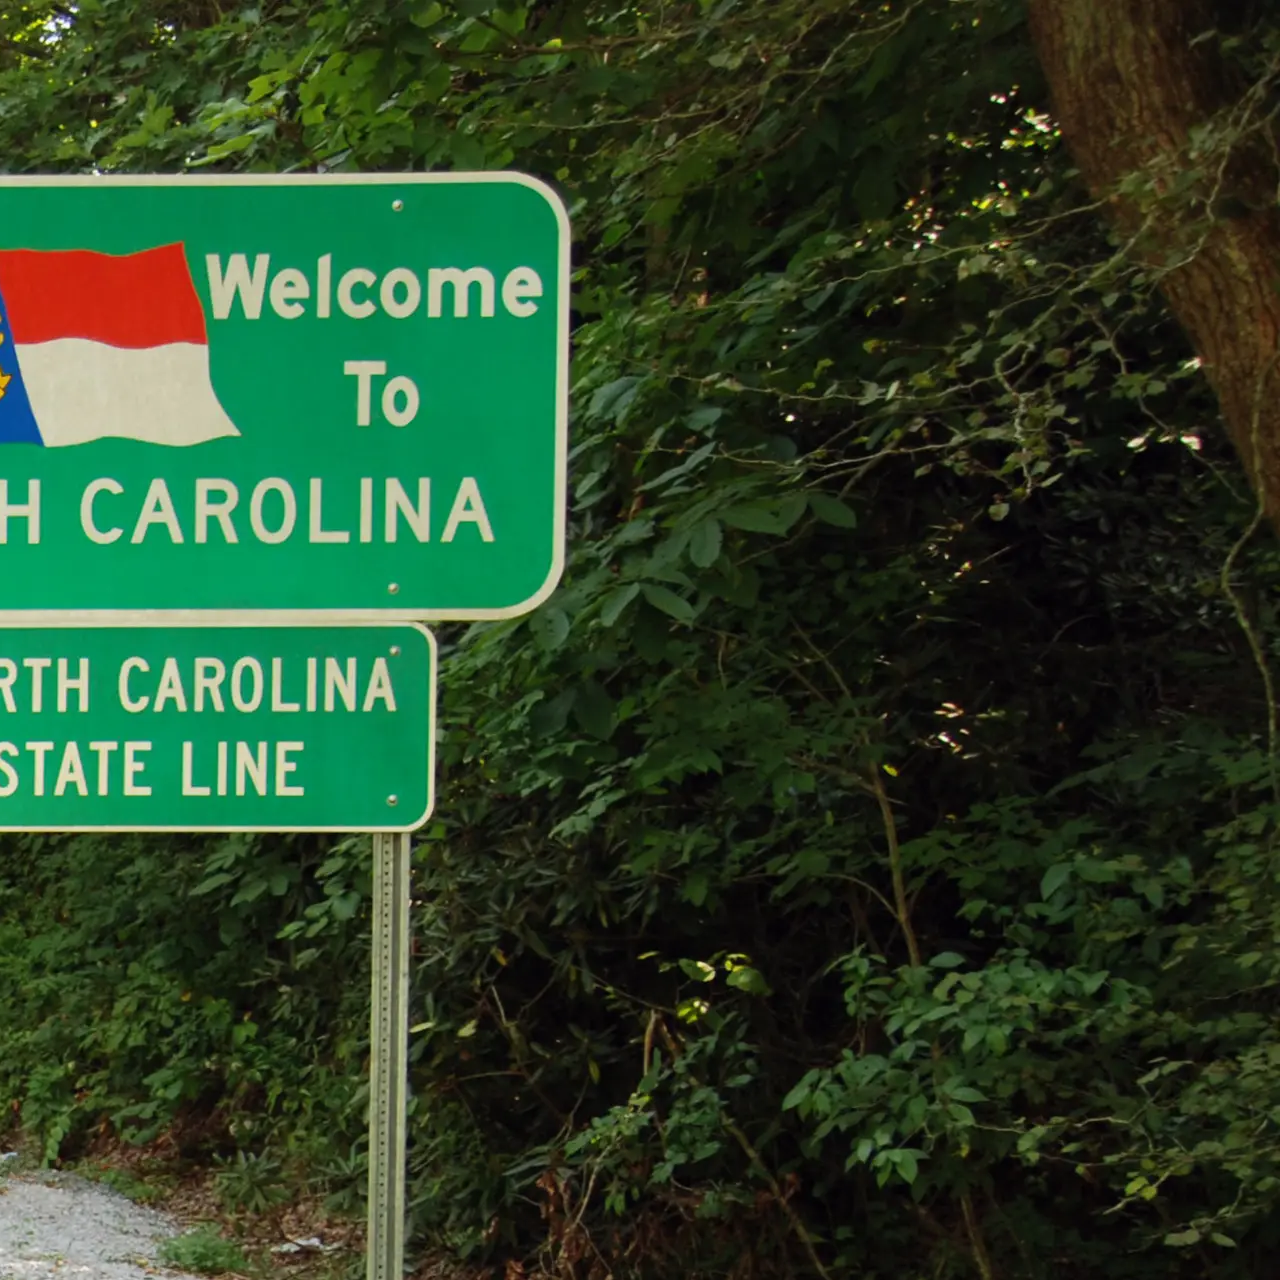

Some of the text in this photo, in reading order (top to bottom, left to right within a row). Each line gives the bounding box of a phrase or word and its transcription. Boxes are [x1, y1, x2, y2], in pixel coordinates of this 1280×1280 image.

[206, 253, 544, 319] Welcome
[344, 361, 419, 426] To
[80, 477, 494, 544] CAROLINA
[119, 656, 397, 713] CAROLINA
[182, 741, 304, 796] LINE
